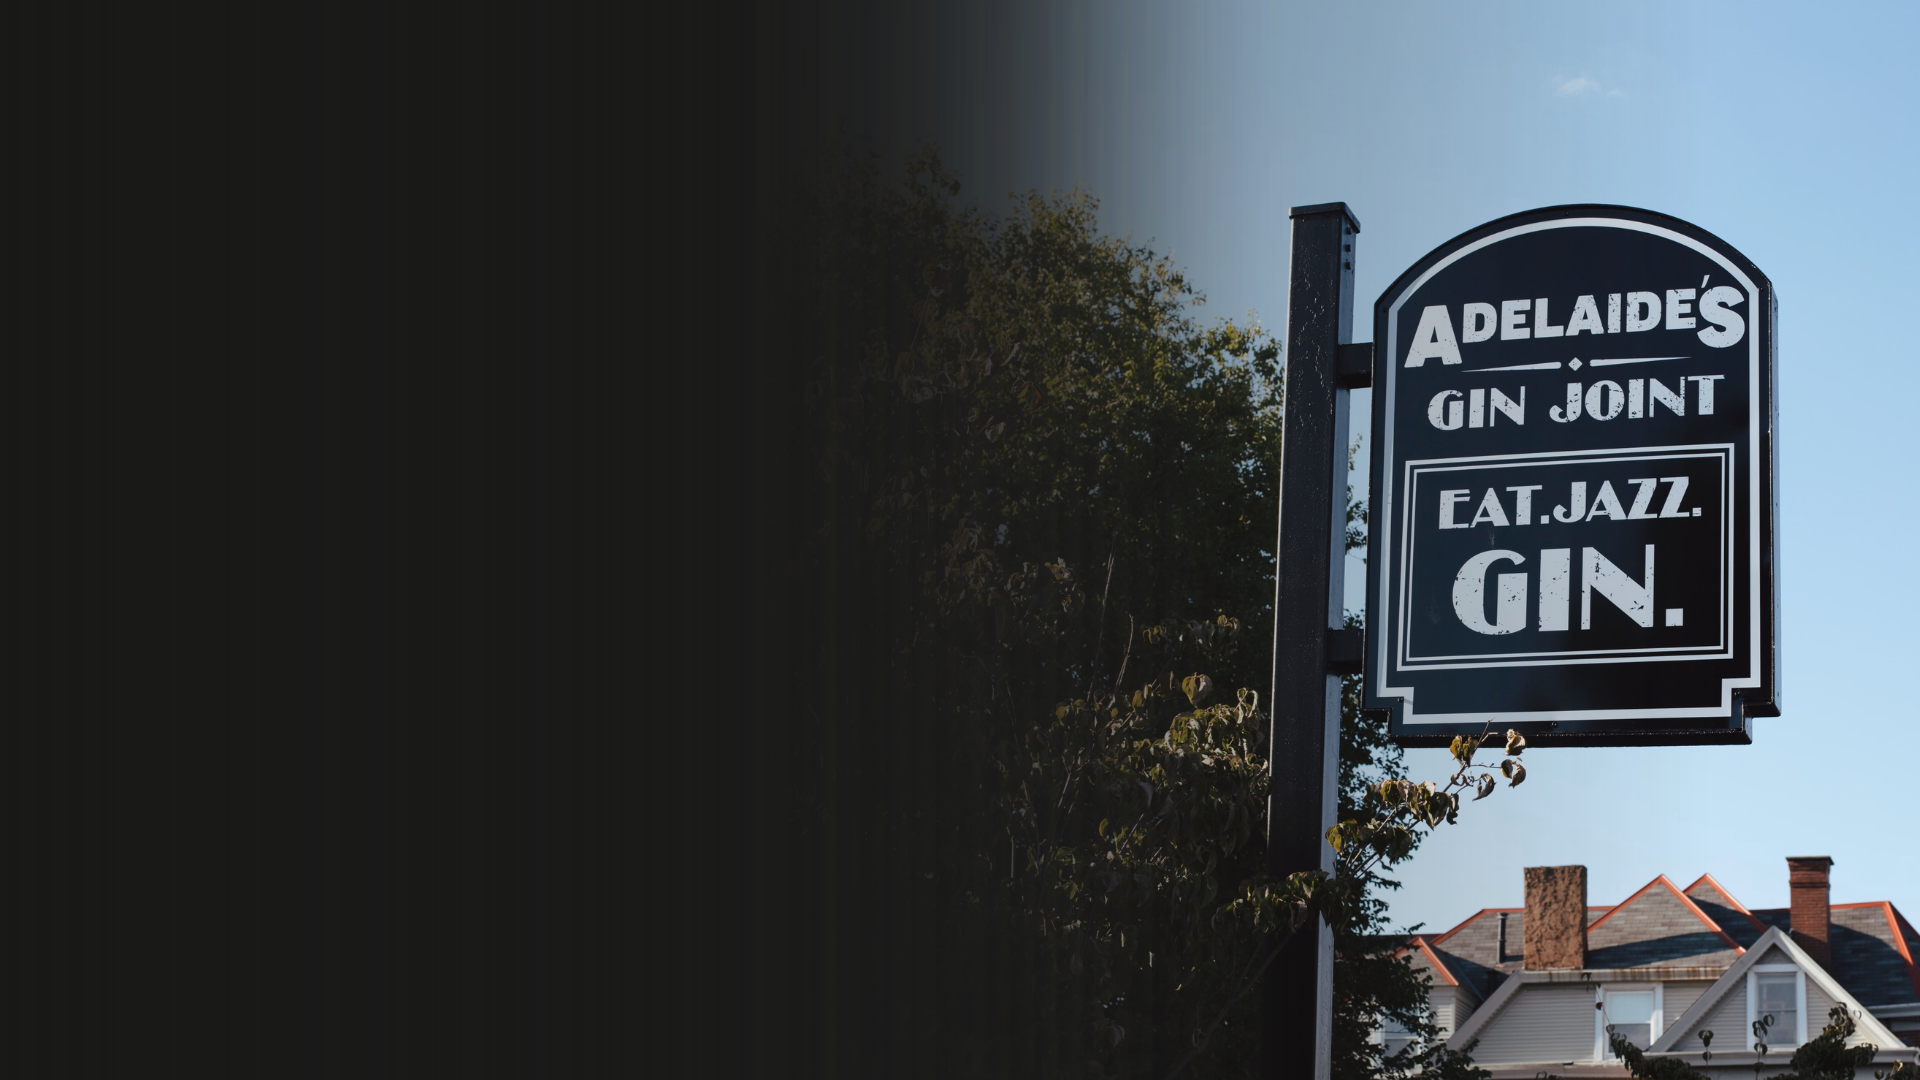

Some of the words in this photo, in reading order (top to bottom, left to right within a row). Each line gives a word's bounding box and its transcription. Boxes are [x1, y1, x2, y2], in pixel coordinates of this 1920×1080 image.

[1403, 274, 1745, 368] ADELAIDE'S
[1427, 386, 1526, 431] GIN
[1549, 374, 1726, 423] JOINT
[1452, 544, 1684, 636] GIN.
